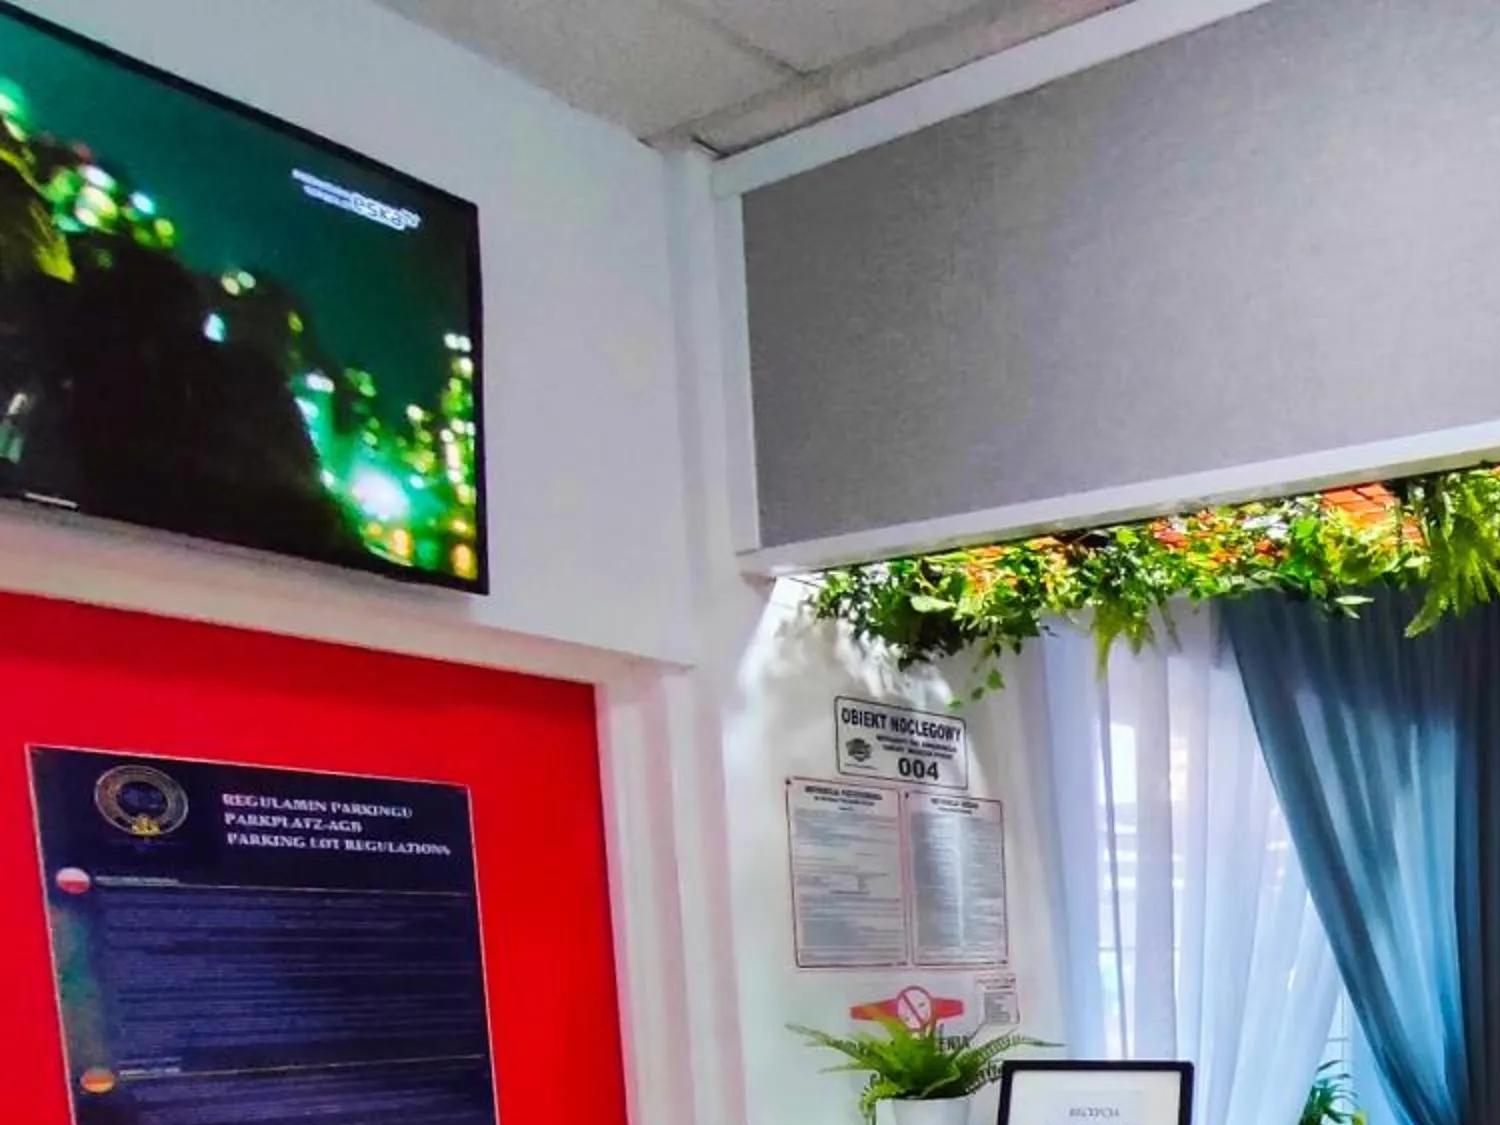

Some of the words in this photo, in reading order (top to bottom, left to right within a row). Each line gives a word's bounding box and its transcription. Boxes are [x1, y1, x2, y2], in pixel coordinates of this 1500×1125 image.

[841, 707, 887, 729] OBIEKT
[890, 716, 961, 741] NOCLEGOWY
[898, 757, 939, 781] 004
[222, 793, 327, 813] REGULAMIN
[331, 800, 413, 819] PARKINGU
[227, 832, 306, 849] PARKING
[309, 837, 341, 851] LOT
[344, 838, 452, 856] REGULATIONS
